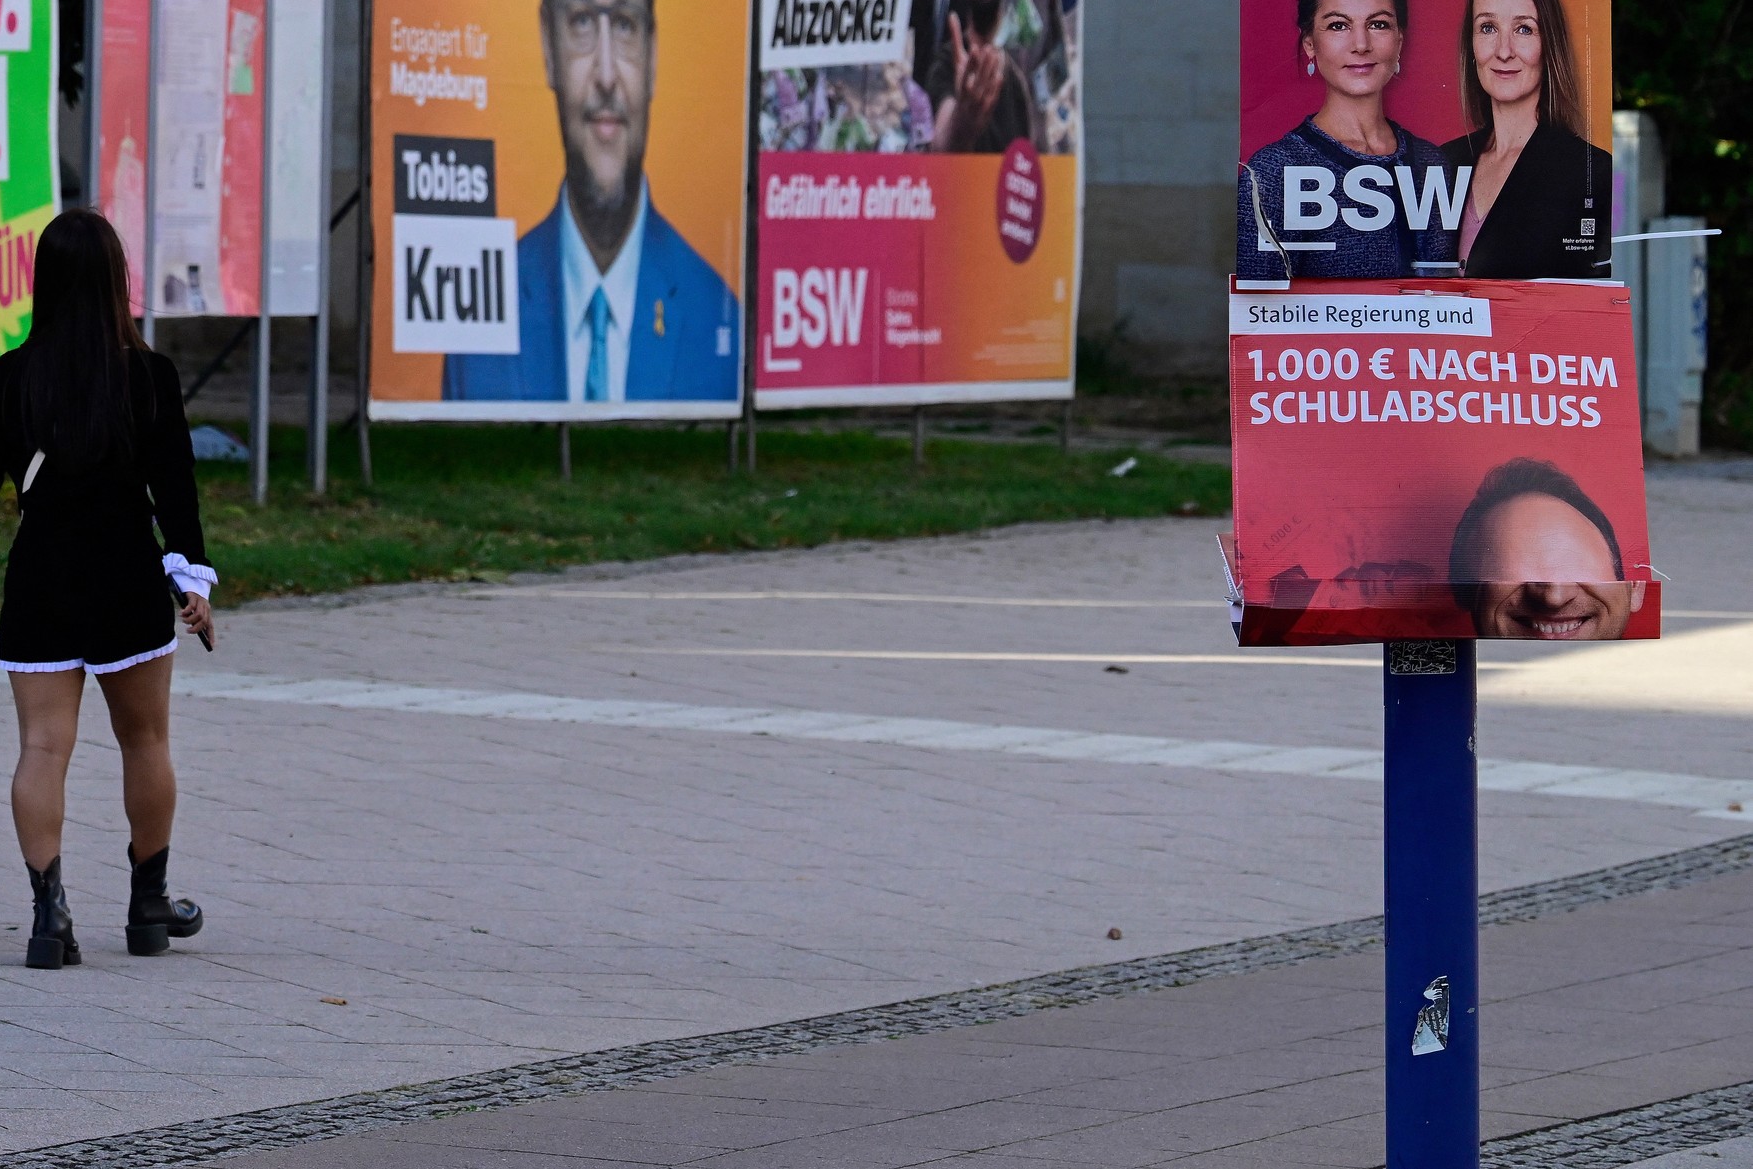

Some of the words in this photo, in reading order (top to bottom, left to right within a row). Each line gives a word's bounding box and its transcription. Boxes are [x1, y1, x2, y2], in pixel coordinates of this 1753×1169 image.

[391, 17, 461, 62] Engagiert
[465, 26, 488, 60] für
[391, 63, 488, 110] Magdeburg
[402, 150, 488, 202] Tobias
[766, 173, 862, 219] Gefährlich
[863, 175, 936, 220] ehrlich.
[1283, 164, 1473, 232] BSW
[405, 246, 504, 322] Krull
[773, 267, 868, 348] BSW
[1249, 304, 1320, 325] Stabile
[1325, 305, 1430, 329] Regierung
[1436, 307, 1474, 325] und
[1247, 347, 1360, 383] 1.000
[1368, 347, 1395, 380] €
[1408, 348, 1517, 384] NACH
[1529, 354, 1618, 389] DEM
[1249, 390, 1602, 428] SCHULABSCHLUSS
